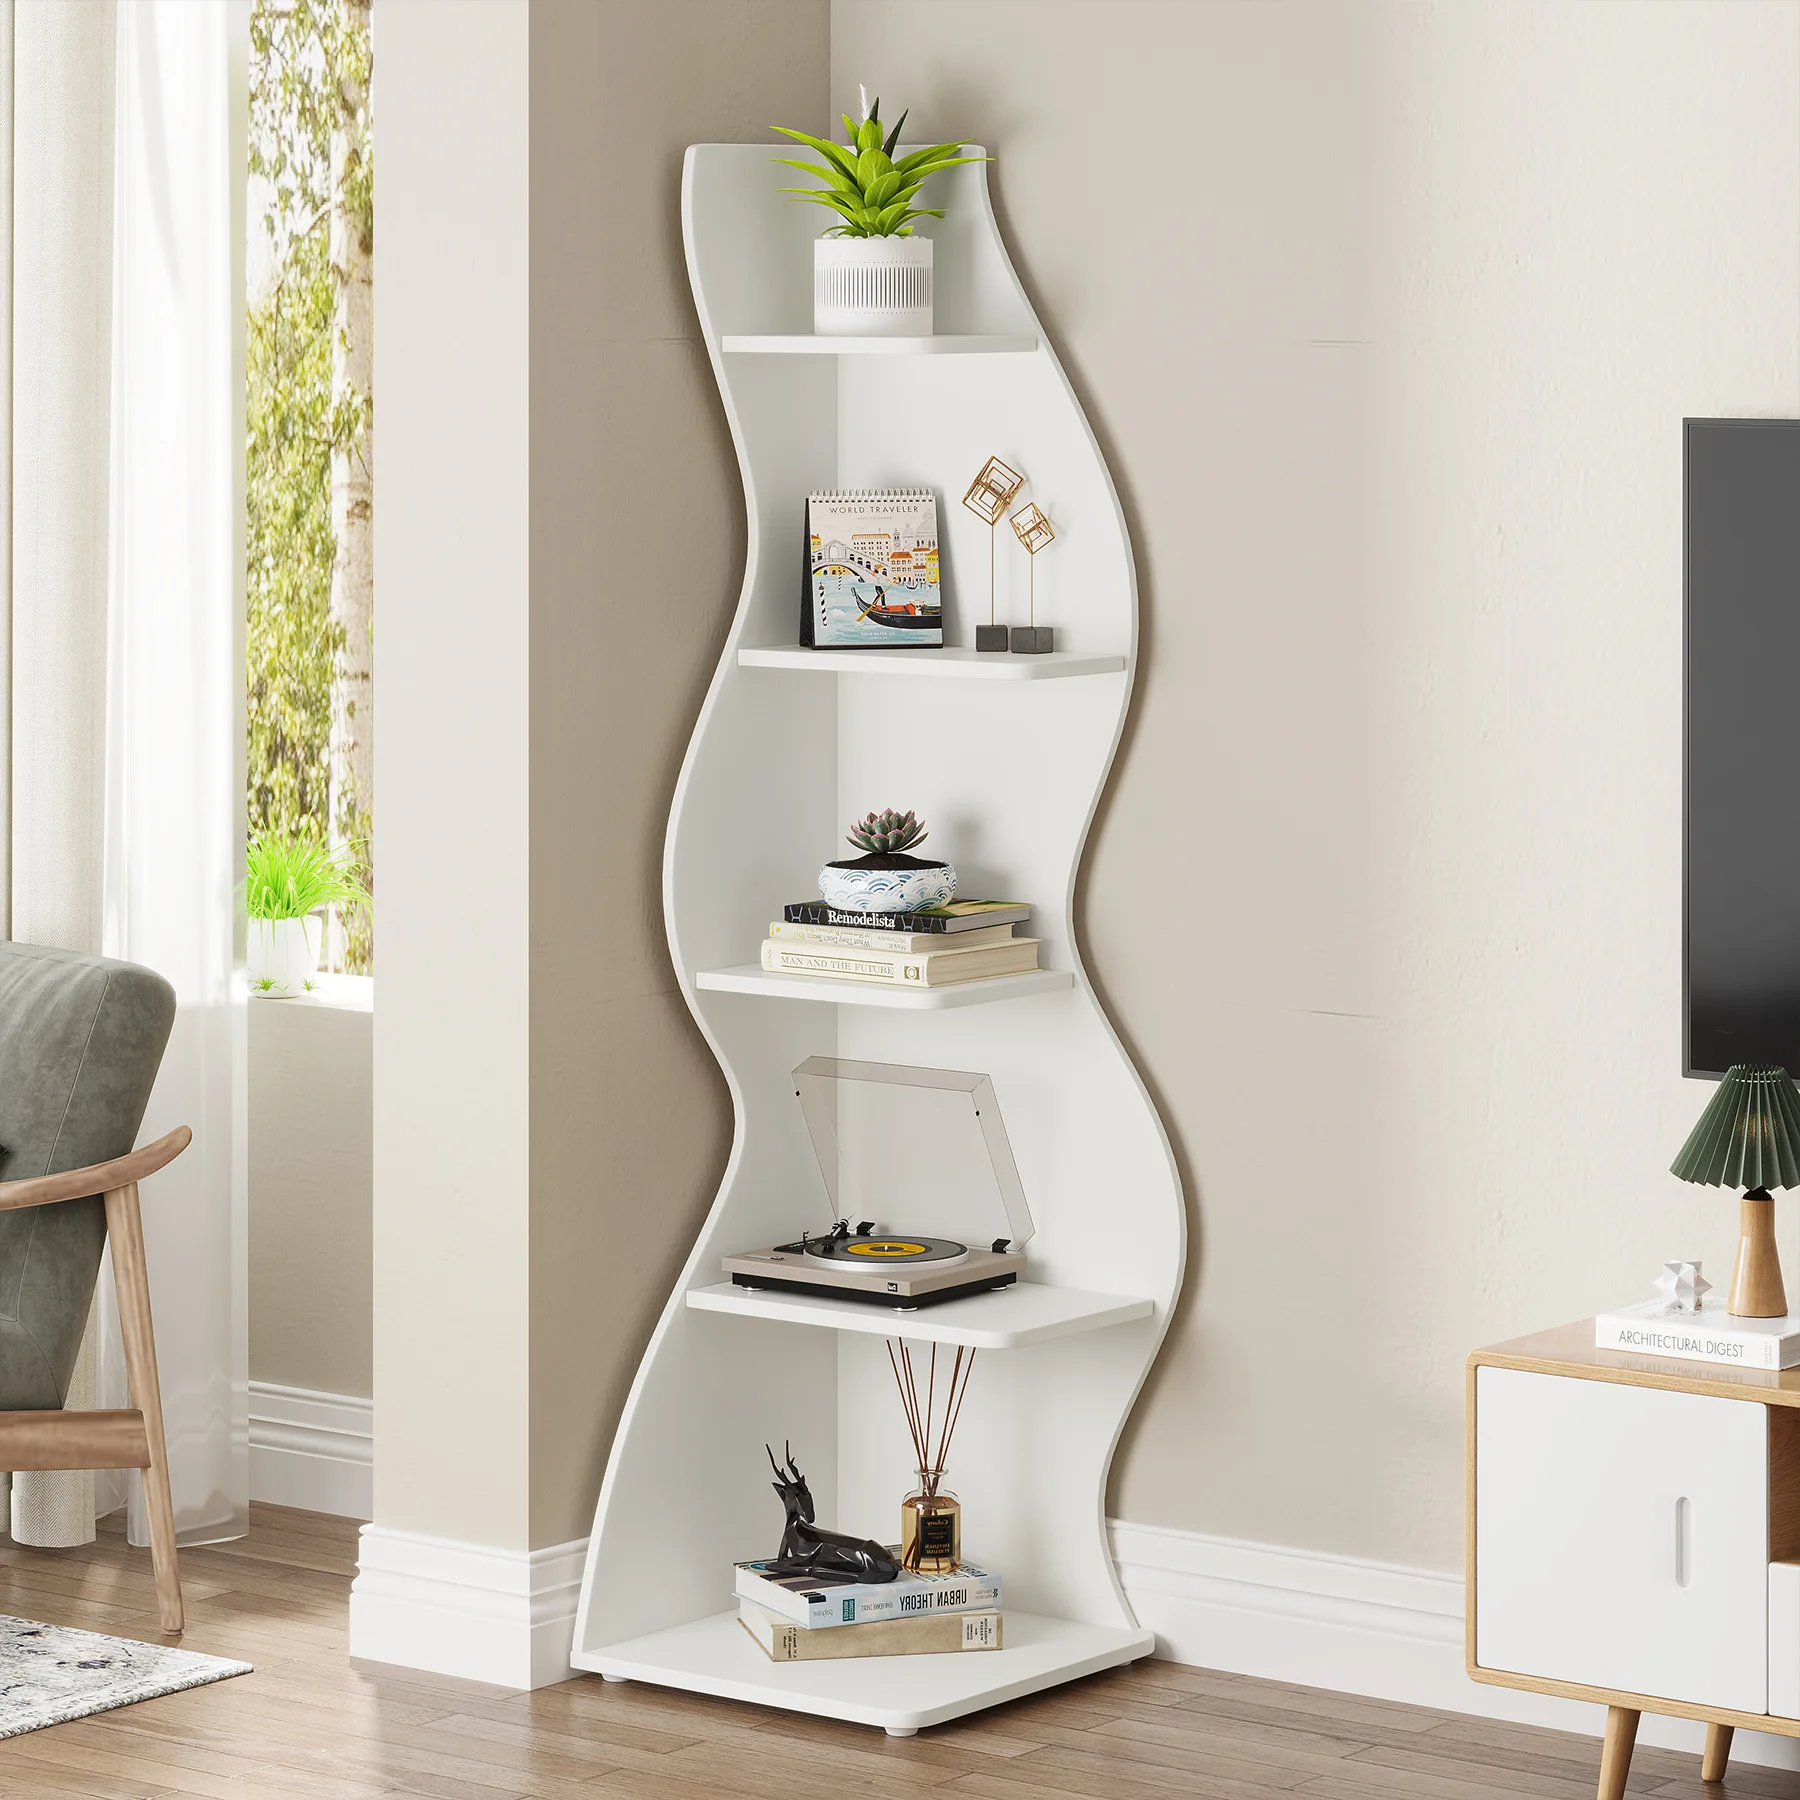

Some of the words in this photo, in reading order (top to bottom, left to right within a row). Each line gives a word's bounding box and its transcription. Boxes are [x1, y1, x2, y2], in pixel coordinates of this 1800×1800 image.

[827, 909, 895, 928] Remodelista
[838, 936, 853, 945] They
[781, 955, 805, 967] MAN
[806, 958, 828, 969] AND
[830, 960, 851, 971] THE
[854, 963, 894, 975] FUTURE
[1619, 1330, 1702, 1353] ARCHITECTURAL
[1706, 1341, 1744, 1358] DIGEST
